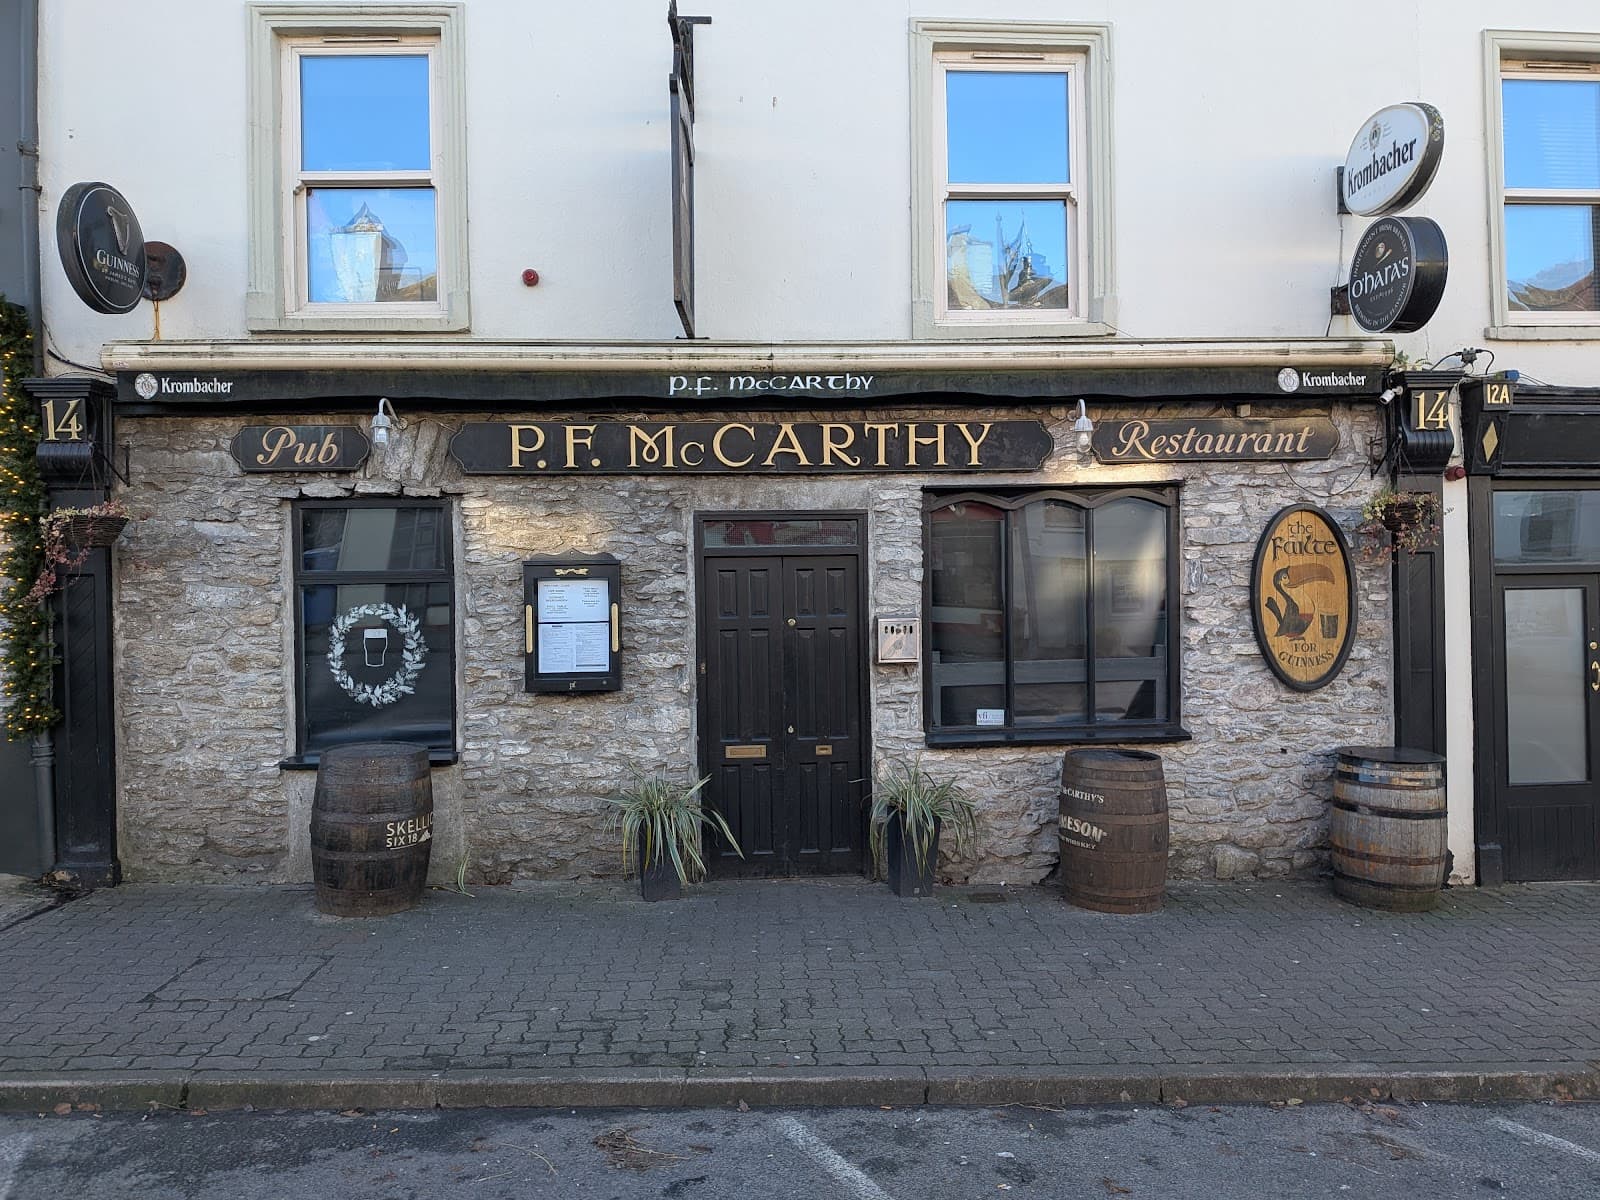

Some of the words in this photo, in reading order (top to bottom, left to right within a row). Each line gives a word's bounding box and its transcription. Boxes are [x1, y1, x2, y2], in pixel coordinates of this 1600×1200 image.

[1348, 138, 1417, 199] Krombacher
[96, 249, 140, 278] GUINNESS
[161, 377, 233, 393] Krombacher
[1303, 371, 1366, 388] Krombacher
[1486, 384, 1510, 404] 12A
[41, 399, 83, 441] 14
[1414, 391, 1449, 430] 14
[256, 426, 339, 467] Pub
[627, 423, 995, 468] McCARTHY
[1111, 420, 1315, 460] Restaurant
[1278, 651, 1334, 667] GUINNESS
[1294, 642, 1317, 652] FOR
[386, 836, 405, 847] SIX
[408, 833, 417, 843] 18
